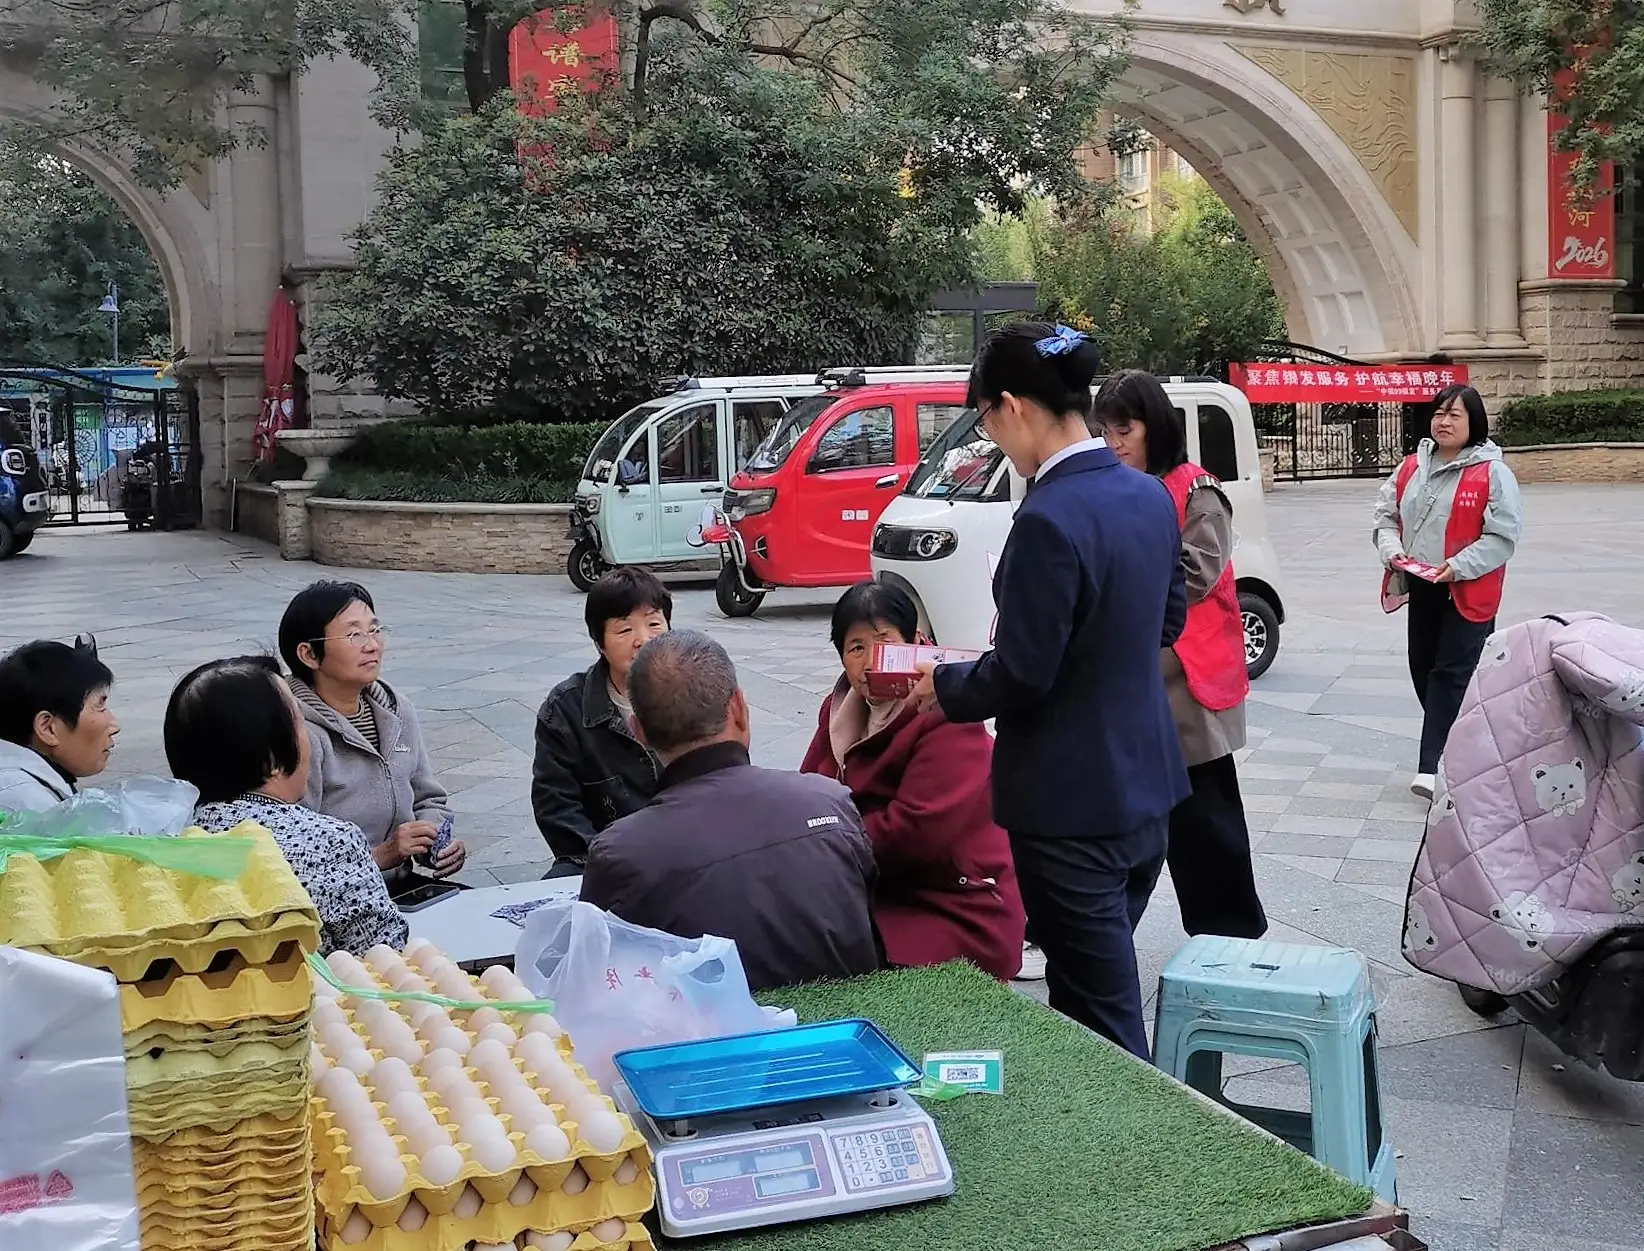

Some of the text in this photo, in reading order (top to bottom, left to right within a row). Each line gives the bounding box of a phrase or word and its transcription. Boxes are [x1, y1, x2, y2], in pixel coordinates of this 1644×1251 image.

[1555, 236, 1609, 270] 2026
[1247, 369, 1455, 386] 聚焦银发服务 护航幸福晚年
[840, 1138, 847, 1148] 7
[855, 1136, 863, 1146] 8
[870, 1133, 878, 1143] 9
[844, 1151, 852, 1161] 4
[860, 1149, 867, 1158] 5
[875, 1146, 883, 1156] 6
[863, 1162, 872, 1171] 2
[878, 1159, 887, 1169] 3
[852, 1177, 860, 1187] 0
